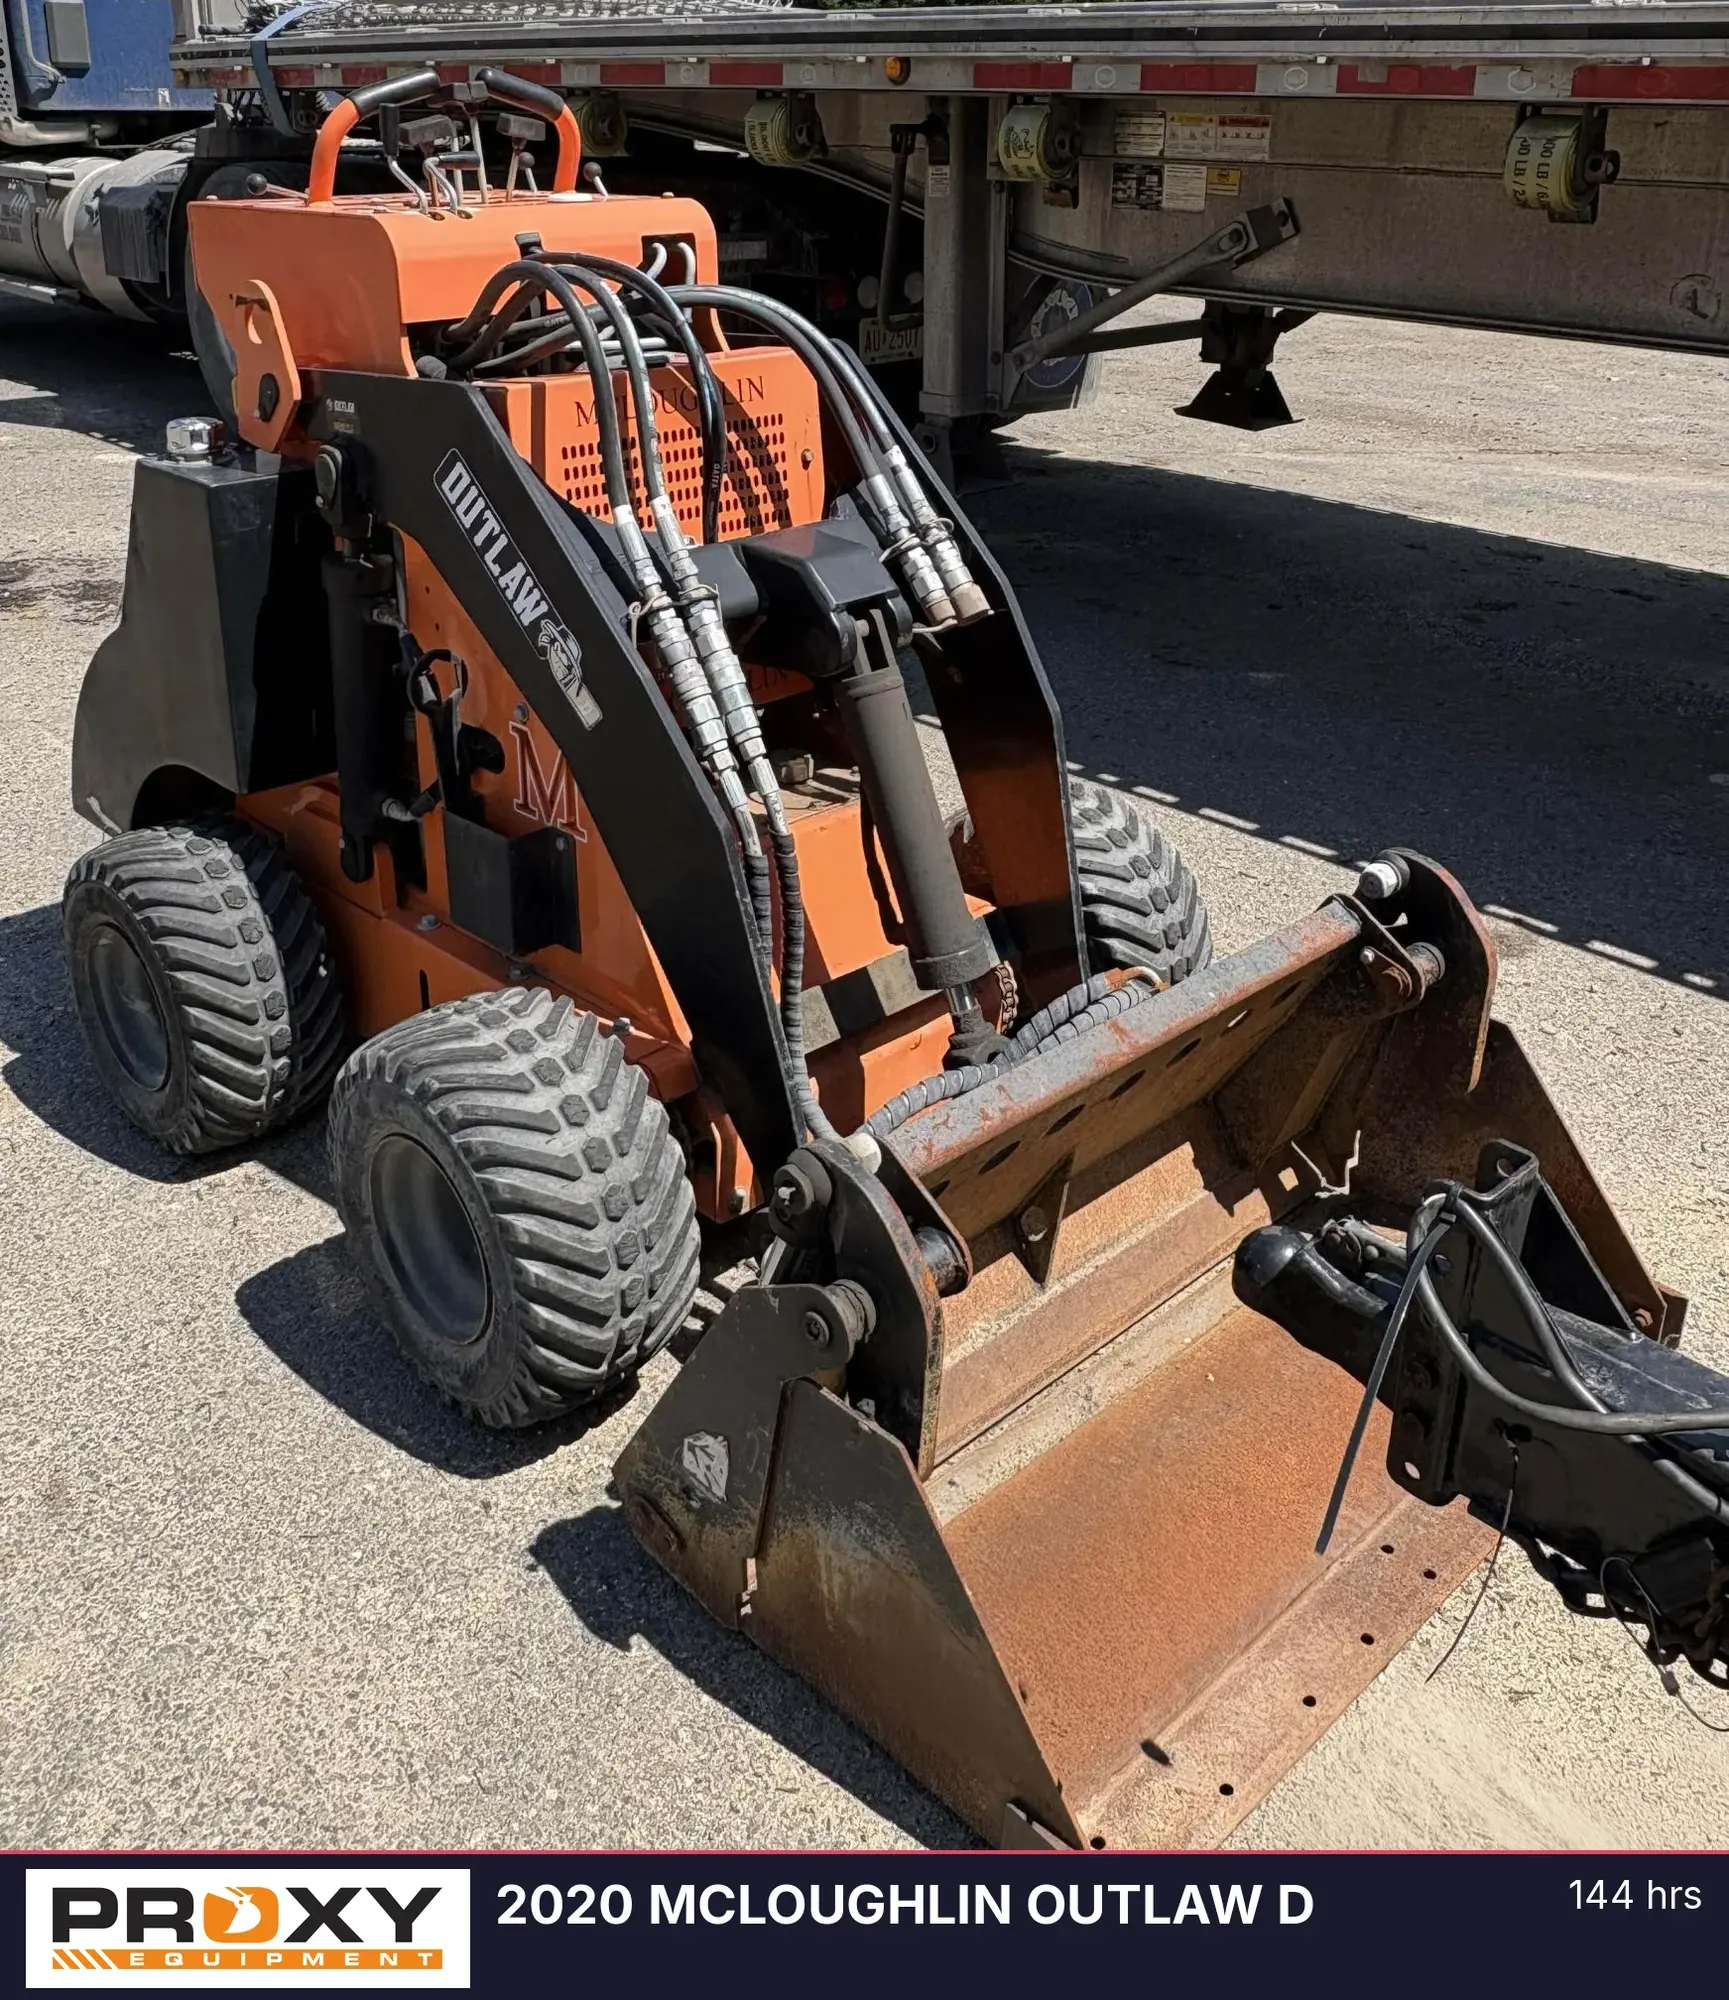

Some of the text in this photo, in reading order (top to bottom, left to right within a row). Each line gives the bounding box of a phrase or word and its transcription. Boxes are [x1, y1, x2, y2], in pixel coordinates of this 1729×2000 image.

[1513, 160, 1528, 177] LB
[1536, 162, 1550, 179] LB
[575, 376, 765, 428] MLUGLIN
[442, 461, 549, 627] OUTLAW
[509, 720, 588, 844] M
